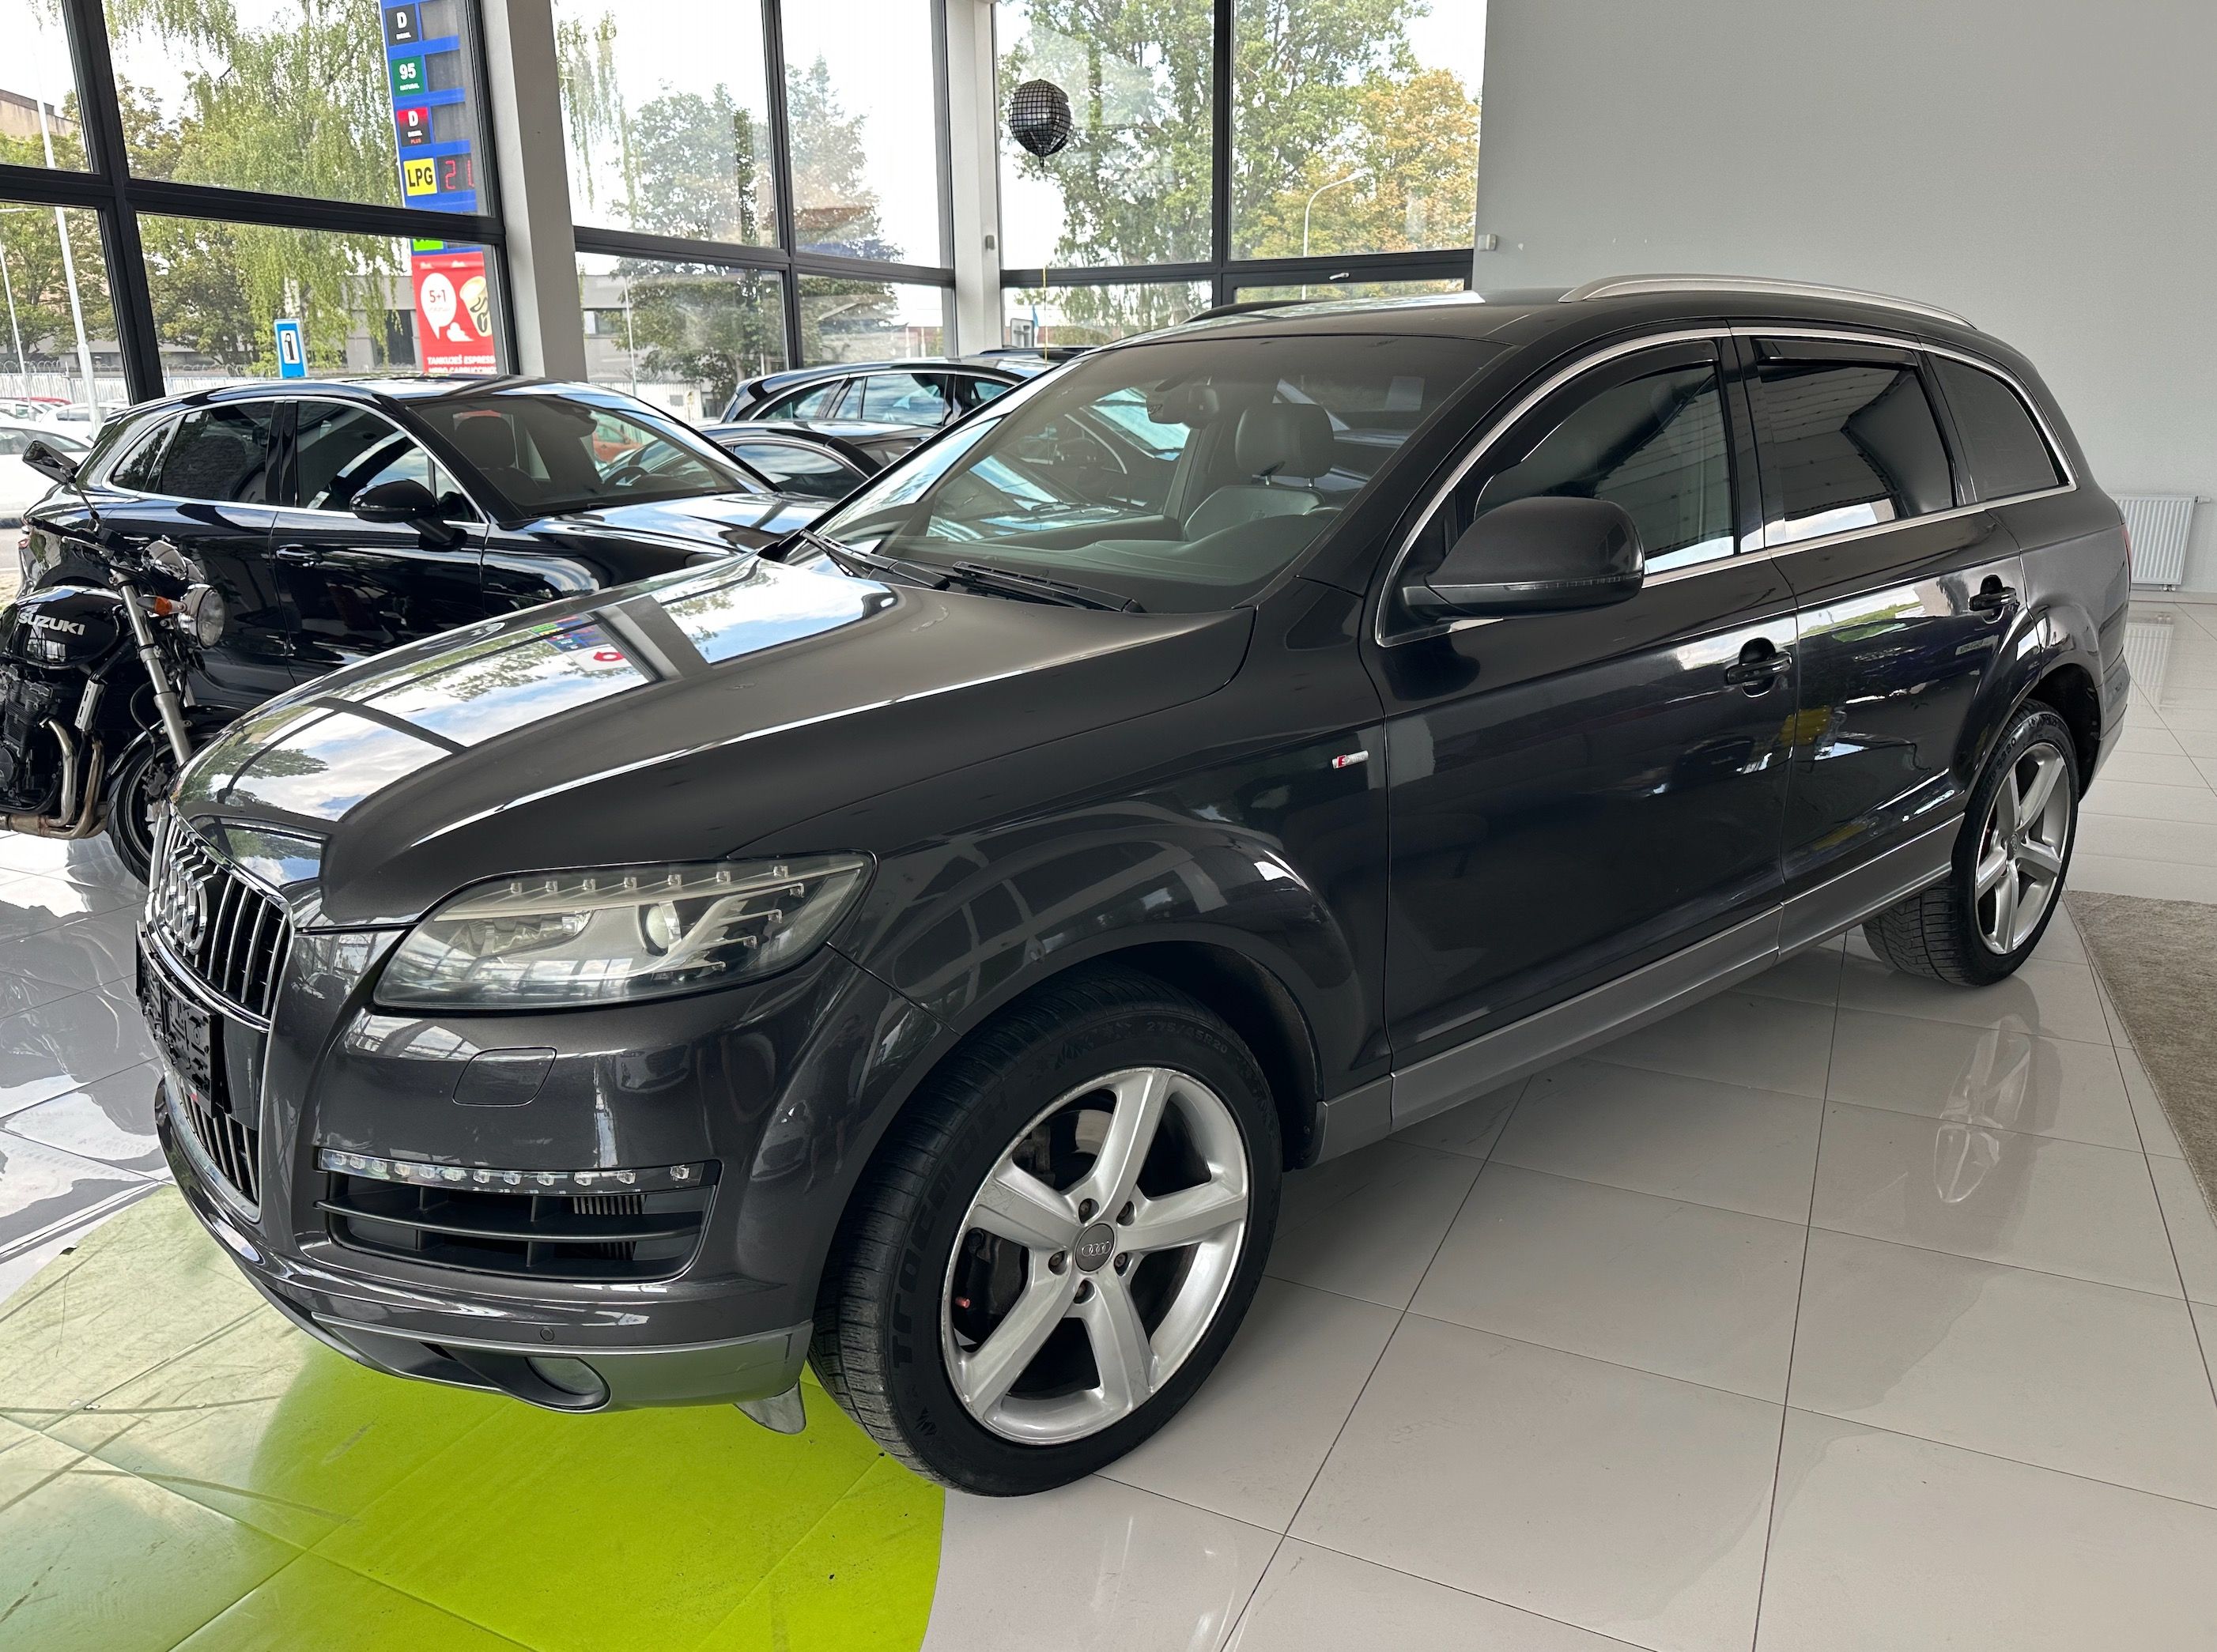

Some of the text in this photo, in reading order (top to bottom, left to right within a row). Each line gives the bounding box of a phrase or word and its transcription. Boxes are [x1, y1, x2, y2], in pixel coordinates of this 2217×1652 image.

[396, 12, 407, 28] D
[399, 62, 417, 80] 95
[408, 111, 418, 126] D
[407, 167, 433, 187] LPG
[429, 289, 447, 304] 5+1
[18, 612, 85, 636] SUZUKI
